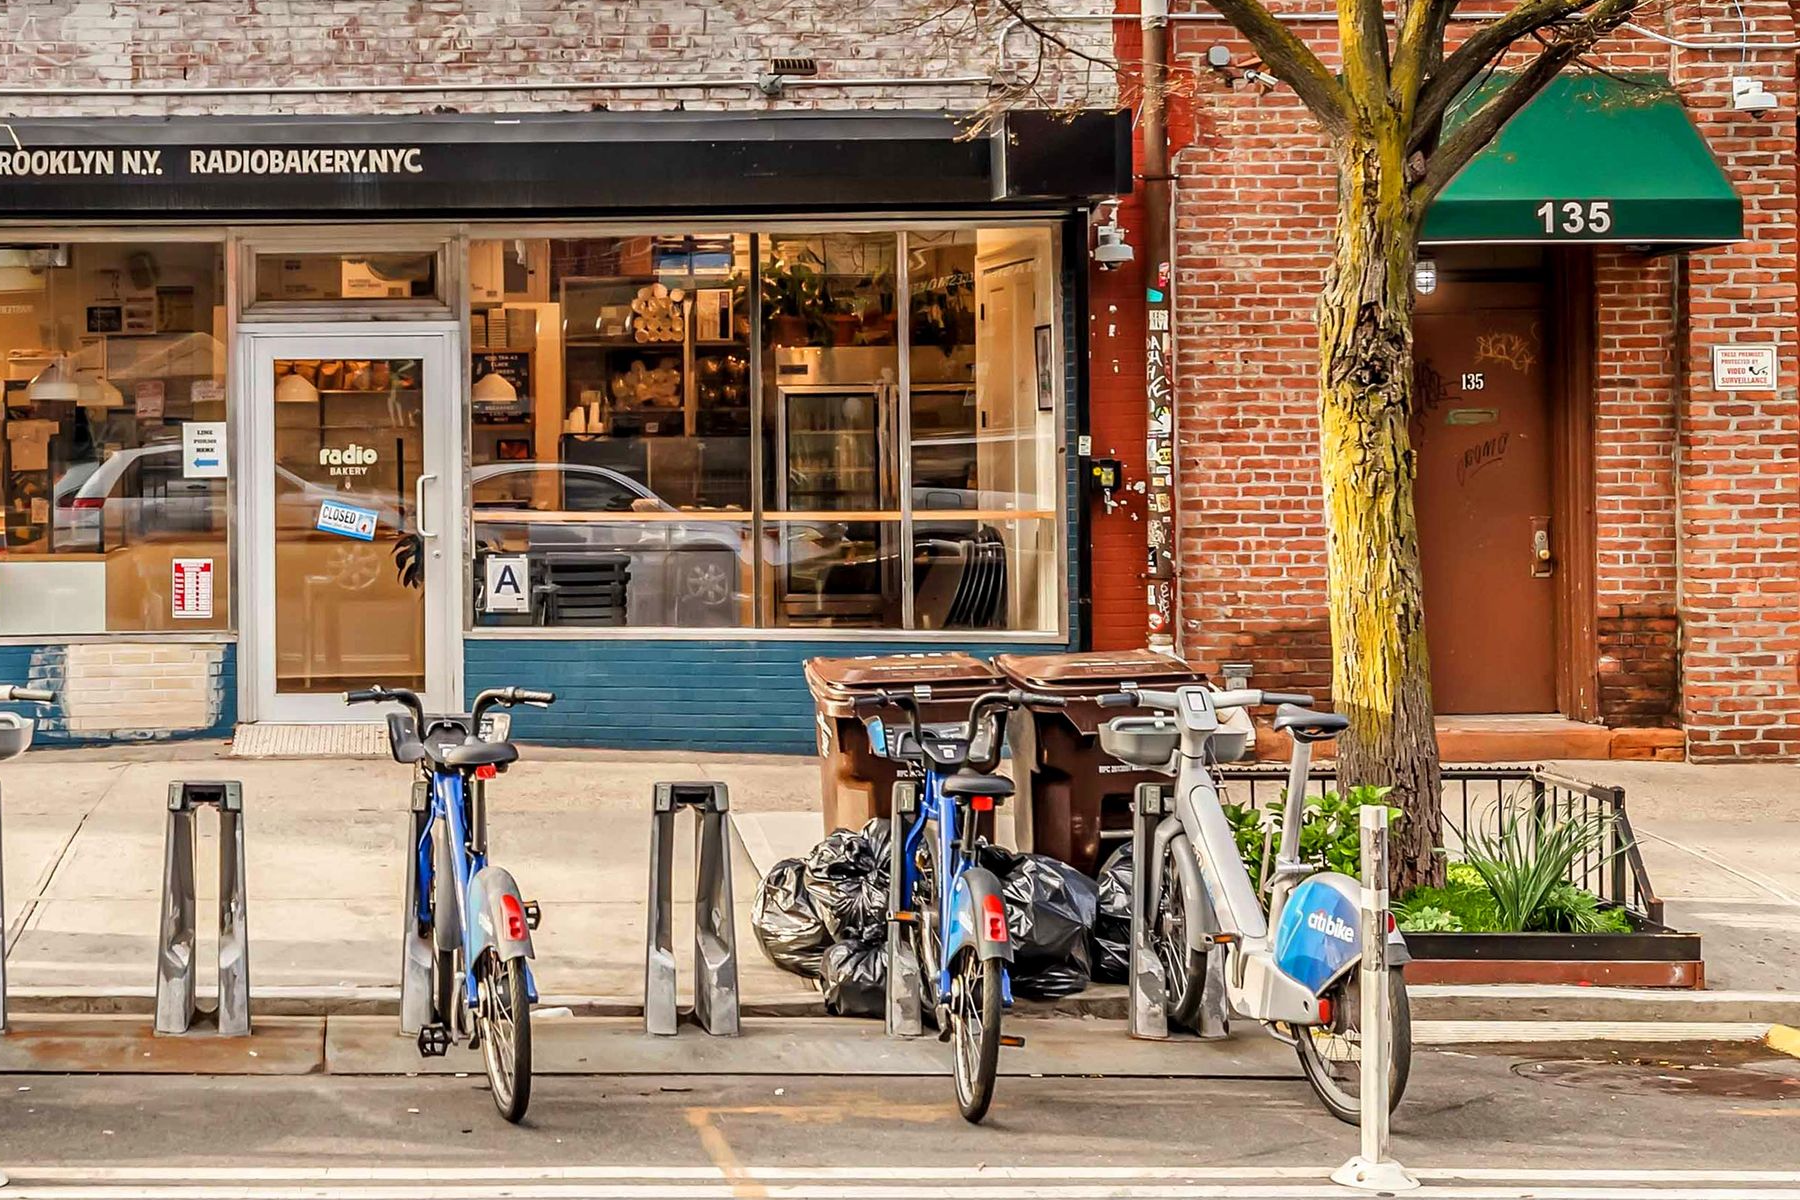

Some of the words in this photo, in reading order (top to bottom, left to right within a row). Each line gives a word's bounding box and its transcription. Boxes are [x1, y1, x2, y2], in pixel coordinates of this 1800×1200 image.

[121, 150, 163, 176] N.Y.
[190, 149, 423, 174] RADIOBAKERY.NYC
[1537, 202, 1611, 233] 135
[1461, 373, 1485, 390] 135
[320, 444, 378, 465] radio
[330, 467, 368, 475] BAKERY
[322, 506, 357, 525] CLOSED
[494, 565, 521, 594] A
[1308, 909, 1327, 932] citi
[1325, 914, 1355, 943] bike
